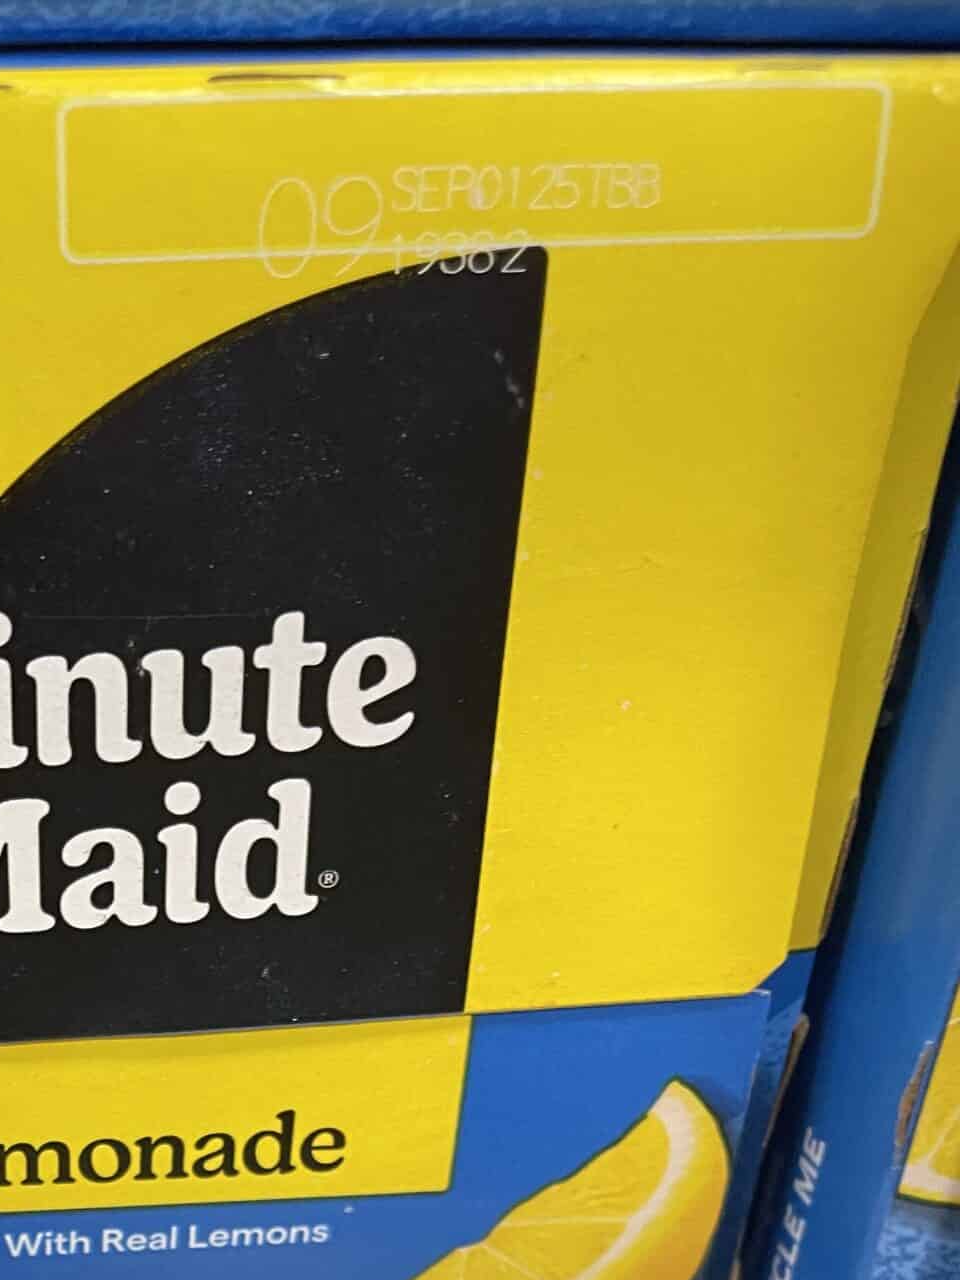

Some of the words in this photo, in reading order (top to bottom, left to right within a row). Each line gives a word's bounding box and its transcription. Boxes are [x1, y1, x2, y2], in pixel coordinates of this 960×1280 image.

[259, 177, 383, 278] 09
[794, 1127, 827, 1206] ME
[5, 1231, 90, 1259] With
[102, 1225, 178, 1254] Real
[188, 1221, 330, 1250] Lemons
